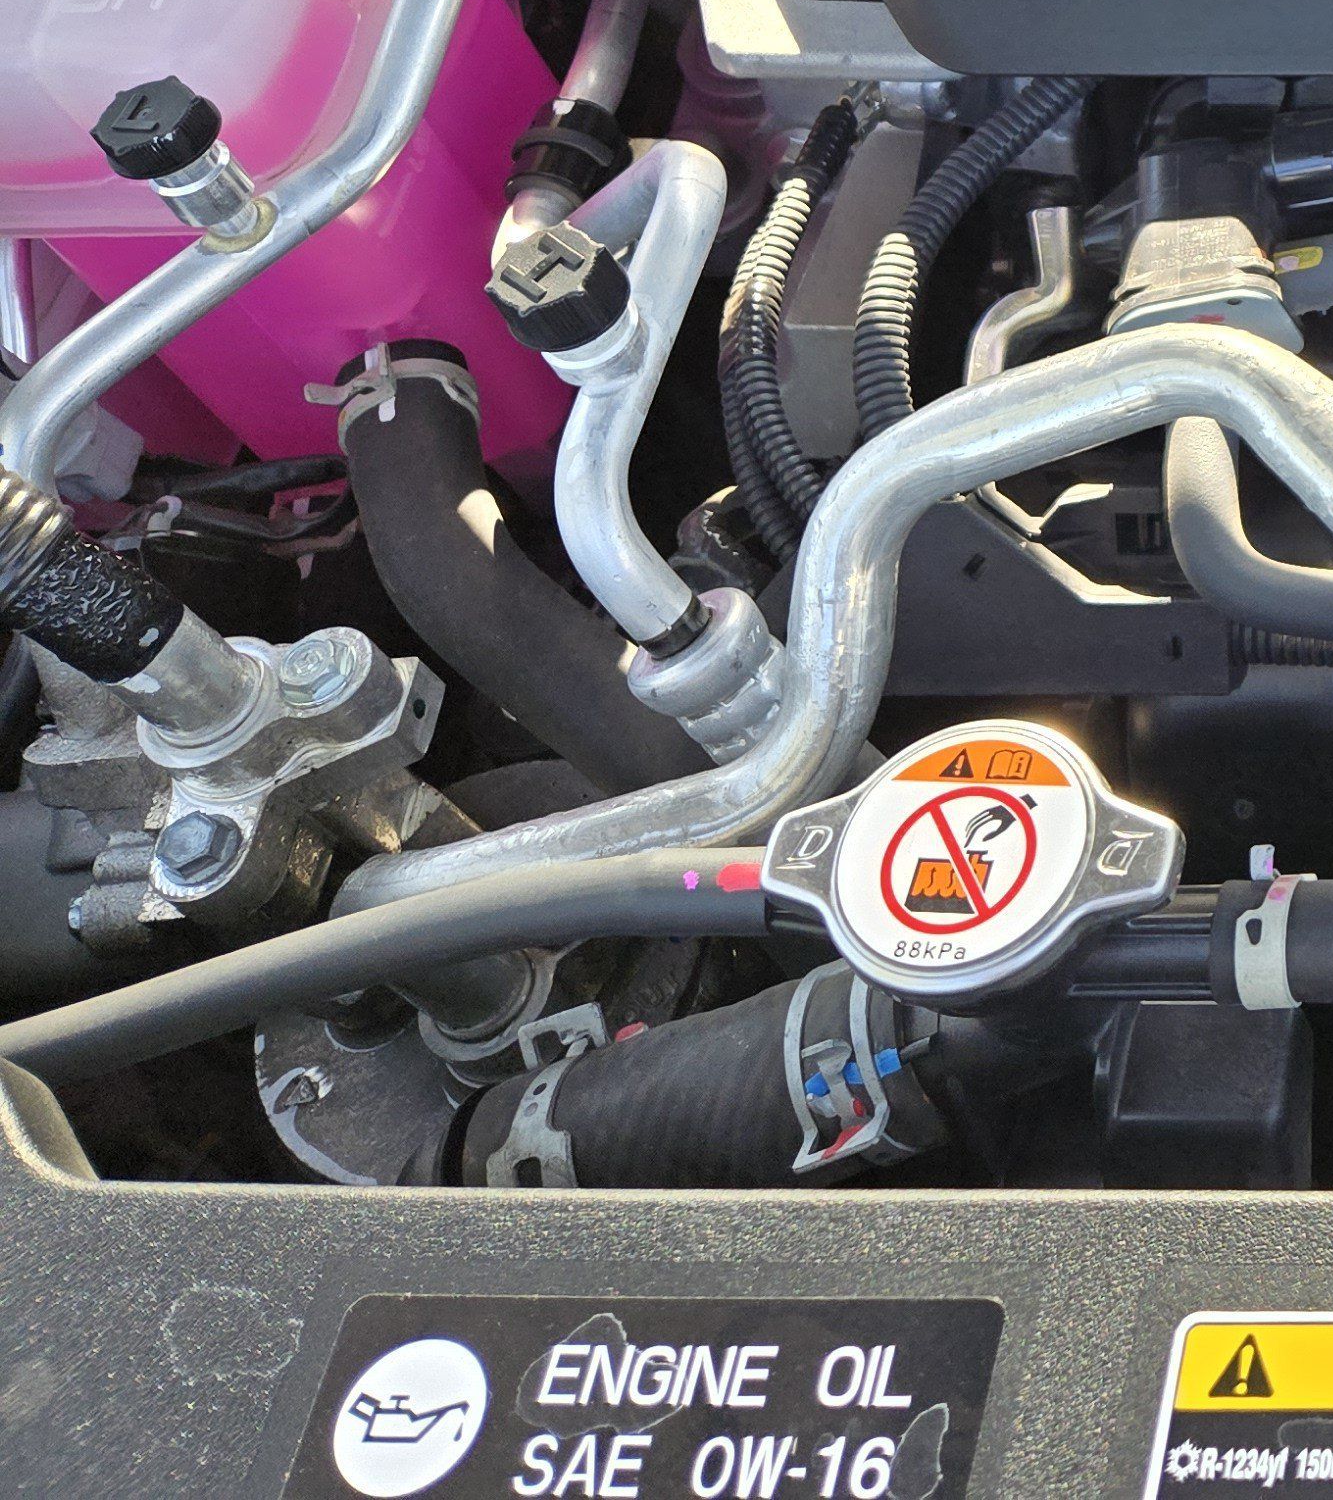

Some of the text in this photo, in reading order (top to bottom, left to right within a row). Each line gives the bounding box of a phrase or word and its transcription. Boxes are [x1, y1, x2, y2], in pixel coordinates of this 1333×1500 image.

[111, 93, 160, 133] L
[500, 231, 586, 304] H
[893, 940, 967, 960] 88kPa
[537, 1345, 912, 1407] ENGINE OIL
[513, 1433, 898, 1498] SAE 0W-16
[1201, 1446, 1287, 1487] R-1234yf
